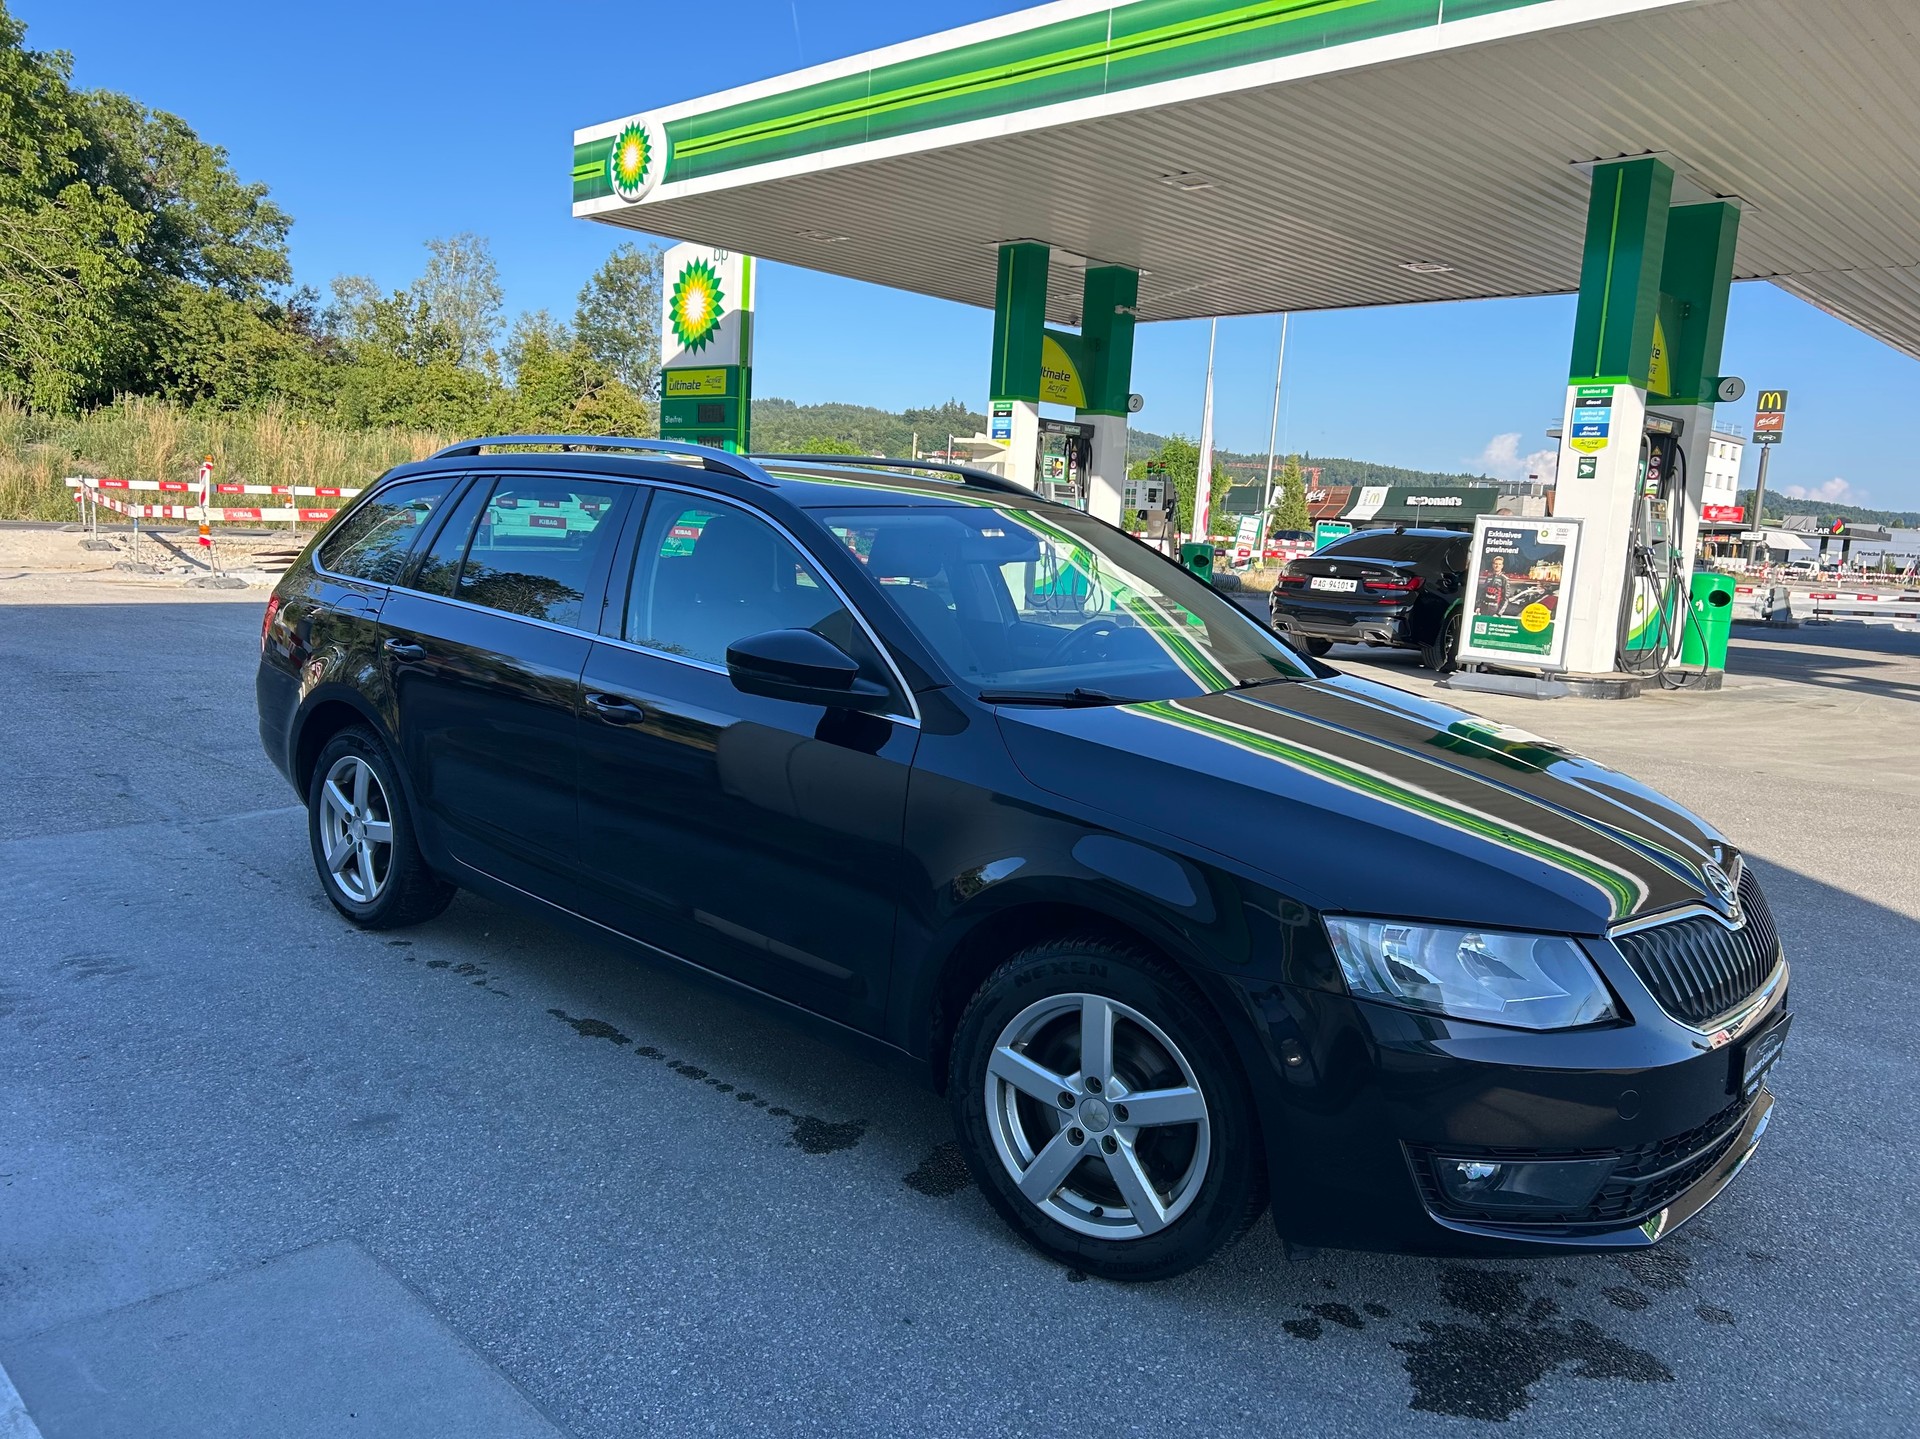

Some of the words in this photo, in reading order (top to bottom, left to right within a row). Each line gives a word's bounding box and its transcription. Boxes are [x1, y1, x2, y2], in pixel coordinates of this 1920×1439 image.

[714, 248, 728, 265] bp
[1041, 366, 1071, 382] ltimate
[669, 379, 701, 391] ultimate
[1726, 383, 1735, 396] 4
[1132, 398, 1139, 409] 2
[665, 415, 683, 423] Bleifrei
[1407, 496, 1463, 506] McDonald's
[1487, 530, 1522, 538] Exklusives
[1486, 538, 1513, 546] Erlebnis
[1485, 546, 1519, 554] gewinnen!
[1317, 579, 1327, 588] AG
[1329, 580, 1349, 589] 94101
[1013, 961, 1109, 988] NEXEN
